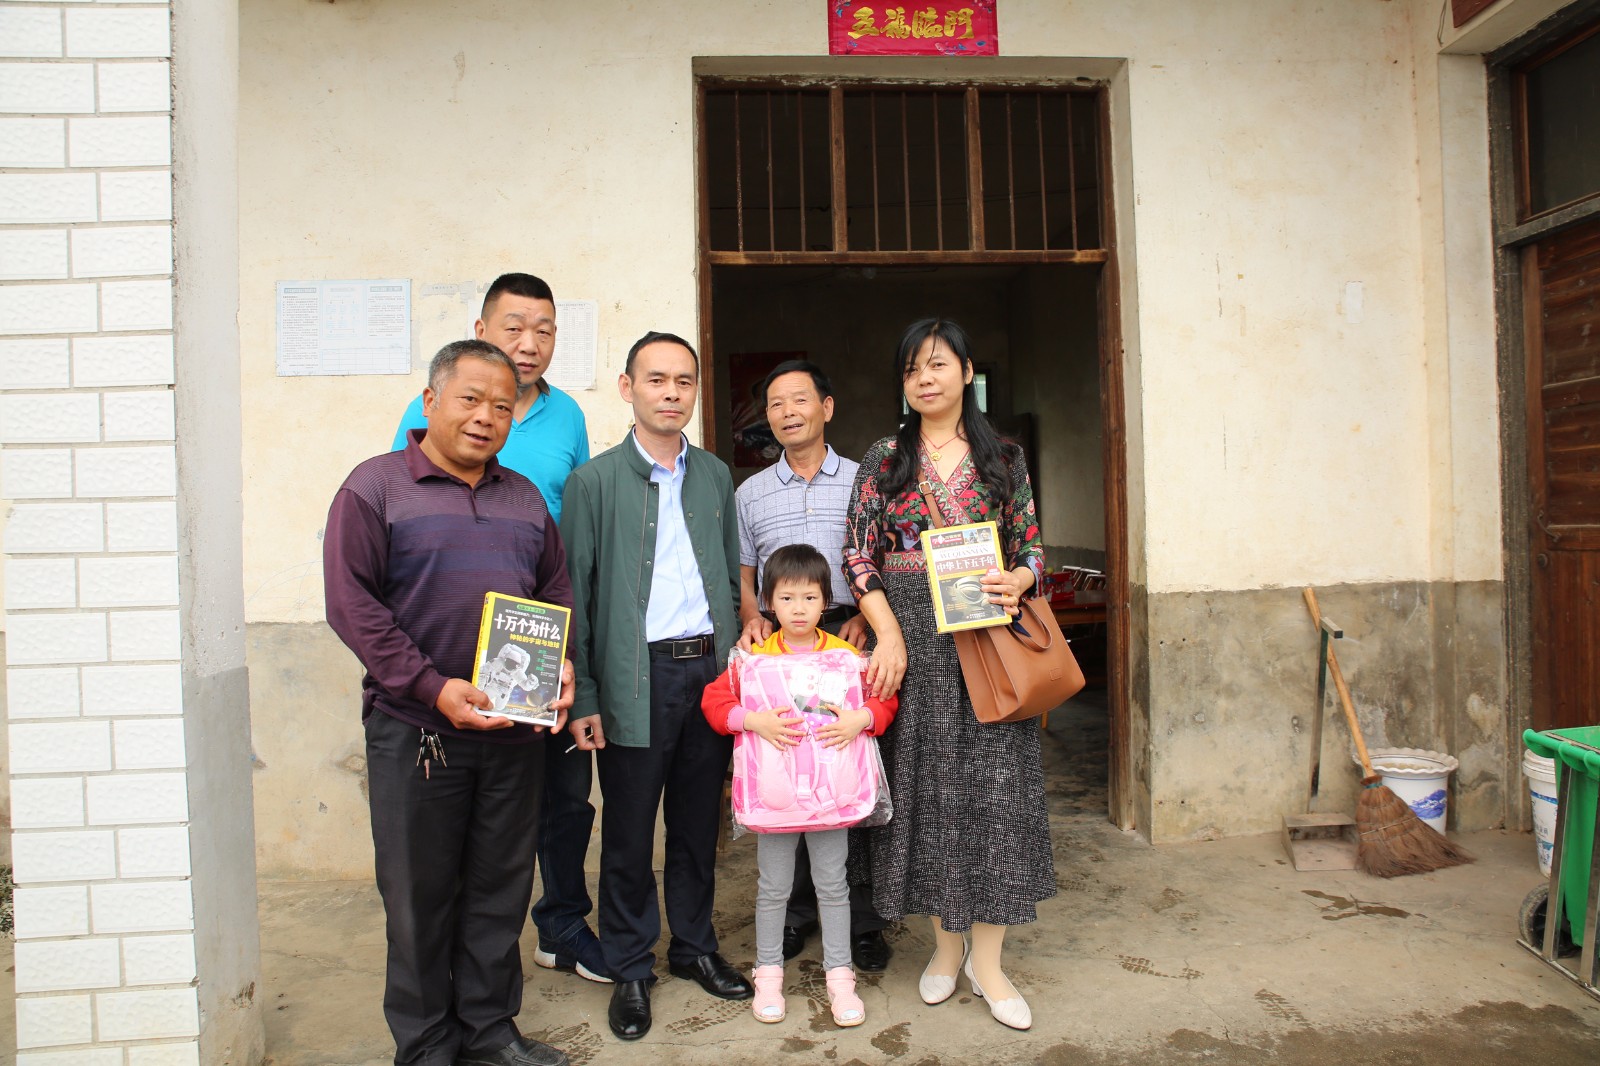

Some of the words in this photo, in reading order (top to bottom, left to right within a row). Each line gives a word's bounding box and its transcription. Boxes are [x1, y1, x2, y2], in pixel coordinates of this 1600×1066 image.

[936, 556, 995, 572] 中华上下五千年
[494, 613, 561, 640] 十万个为什么
[509, 633, 560, 649] 神秘的宇宙与地球
